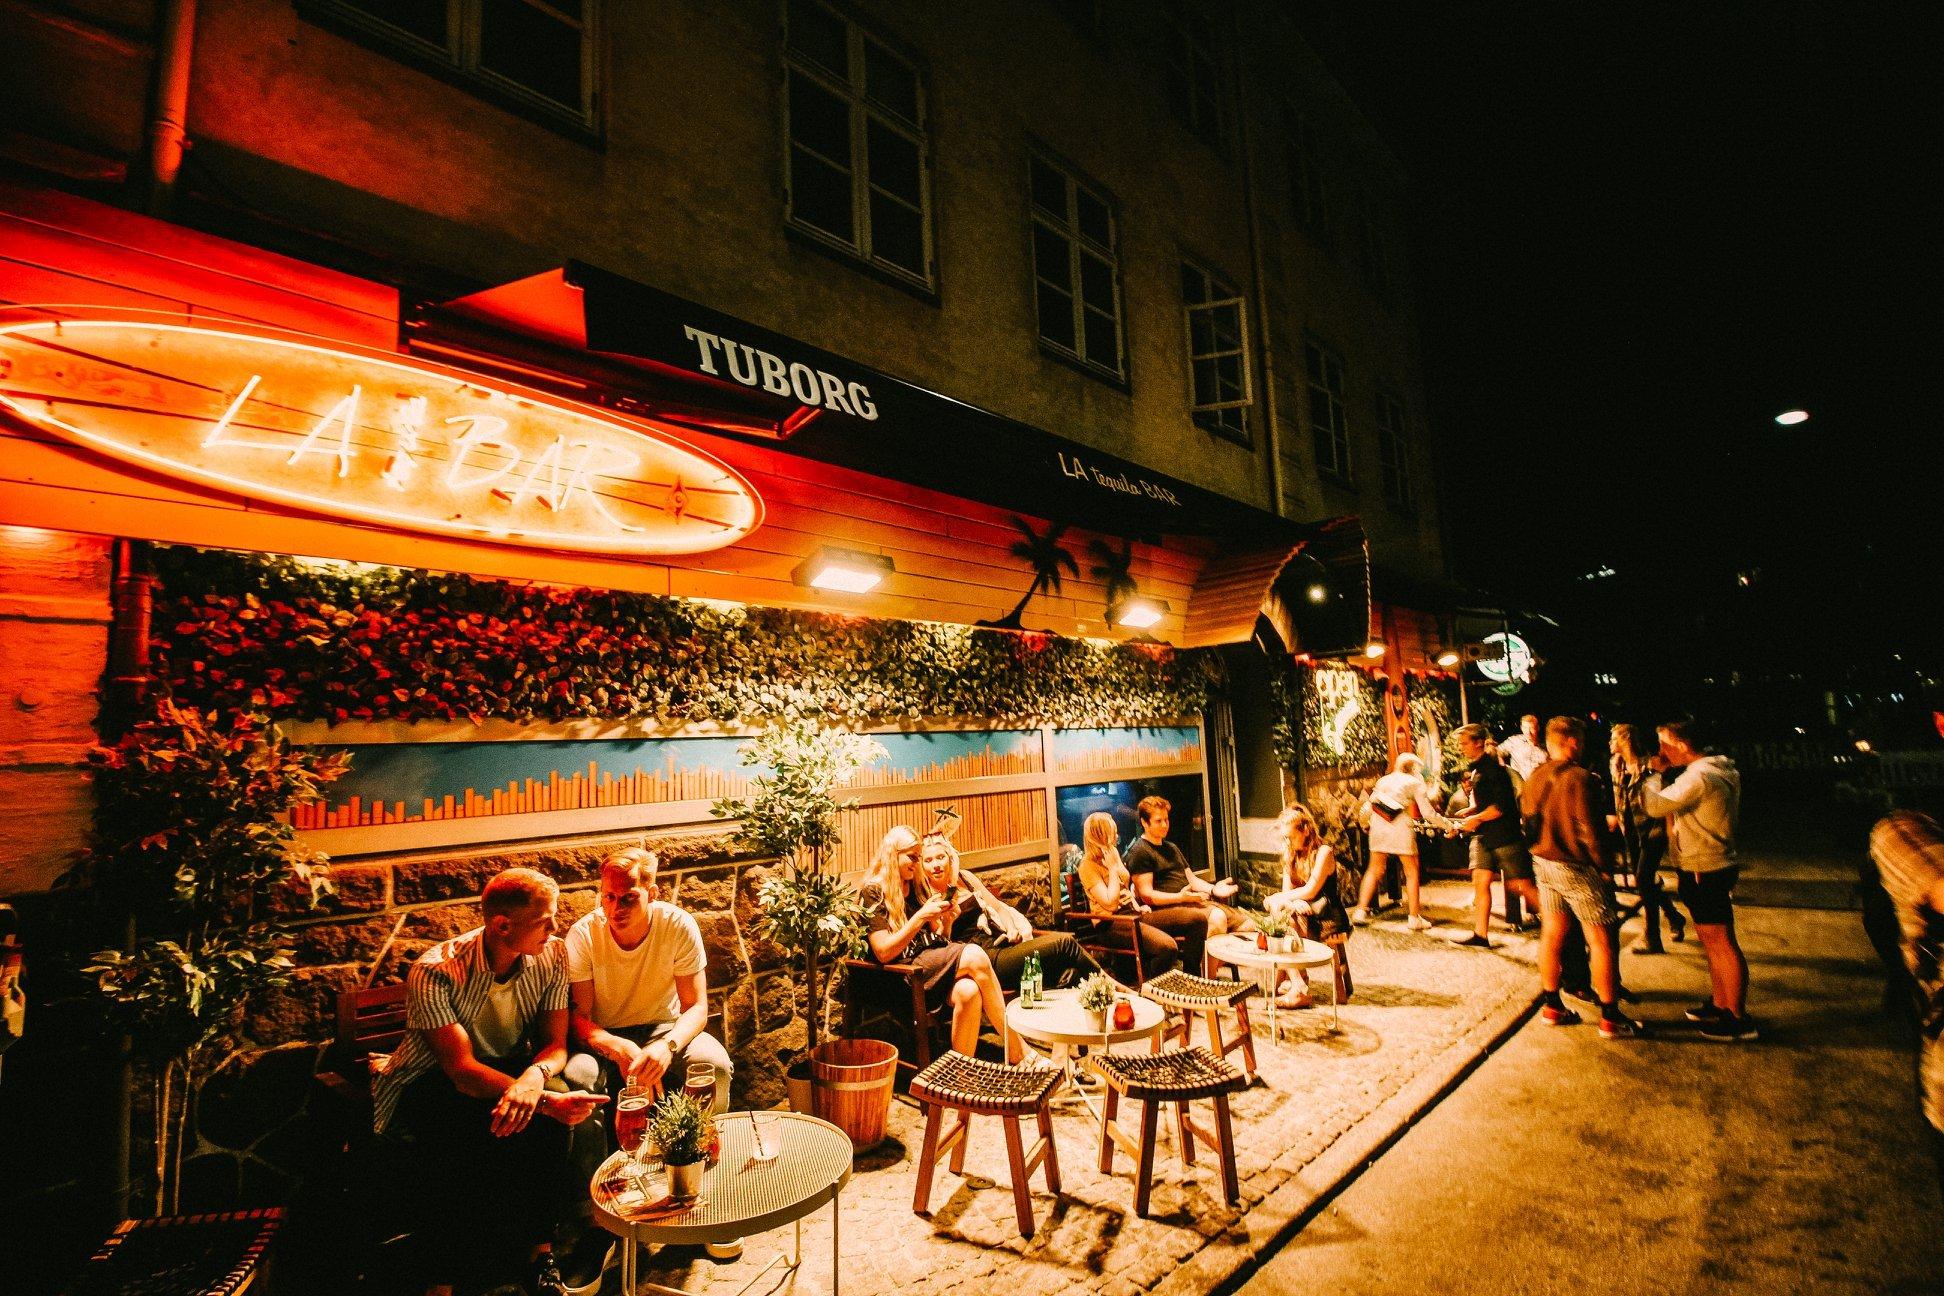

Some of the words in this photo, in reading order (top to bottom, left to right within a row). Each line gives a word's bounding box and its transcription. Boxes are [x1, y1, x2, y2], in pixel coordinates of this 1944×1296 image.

[683, 324, 879, 421] TUBORG
[200, 374, 362, 478] LA
[444, 414, 646, 532] BAR
[1057, 451, 1089, 481] LA
[1139, 479, 1182, 506] BAR
